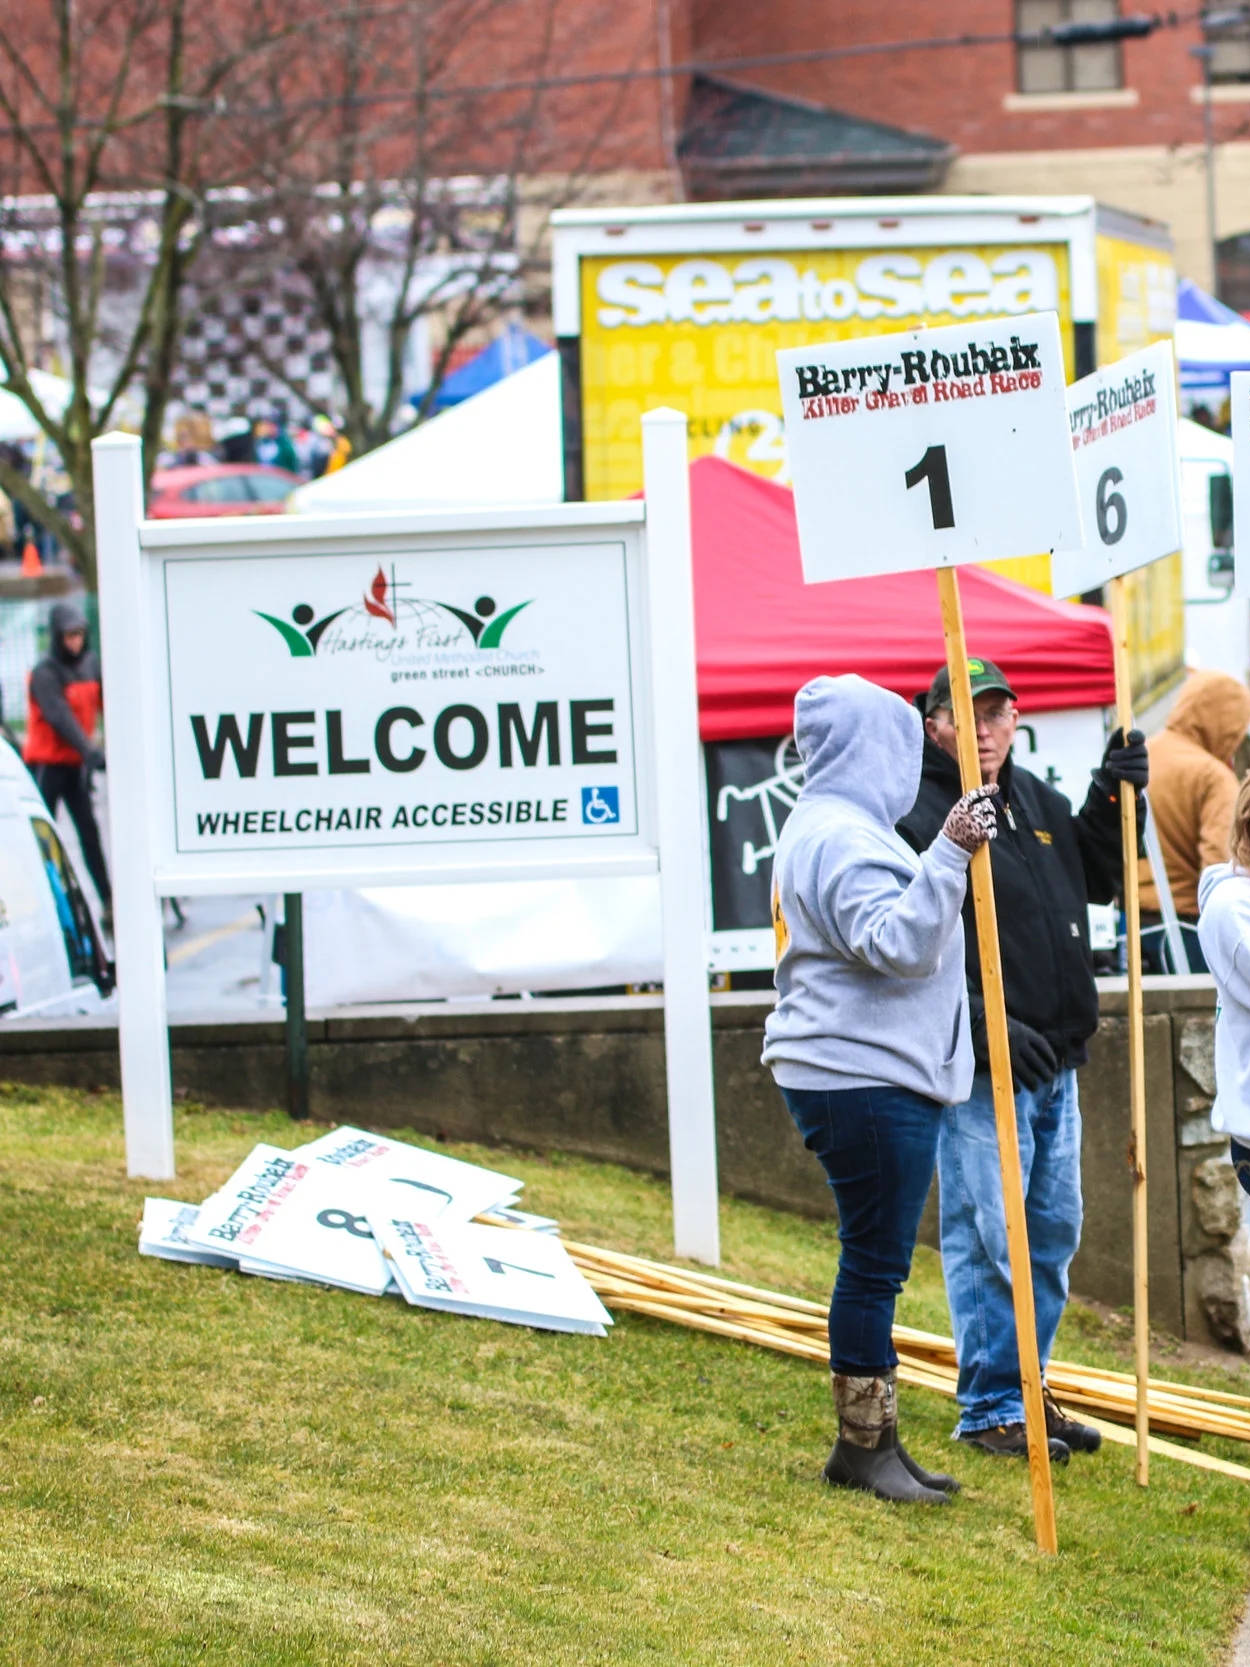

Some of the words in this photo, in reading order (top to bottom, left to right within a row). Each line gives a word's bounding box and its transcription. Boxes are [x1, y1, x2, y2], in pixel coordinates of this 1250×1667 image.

[597, 257, 801, 327] sea
[801, 269, 858, 320] to
[855, 249, 1058, 316] sea
[795, 336, 1042, 399] Barry-Roubaix
[802, 394, 859, 419] Killer
[865, 385, 929, 410] Gravel
[932, 376, 985, 402] Road
[989, 370, 1042, 395] Race
[1069, 367, 1157, 434] rry-Roubaix
[904, 444, 956, 530] 1
[1096, 466, 1128, 546] 6
[391, 670, 427, 683] green
[432, 667, 470, 680] street
[189, 698, 619, 780] WELCOME
[197, 806, 383, 836] WHEELCHAIR
[391, 799, 569, 829] ACCESSIBLE
[316, 1208, 376, 1239] 8
[482, 1256, 556, 1279] 7
